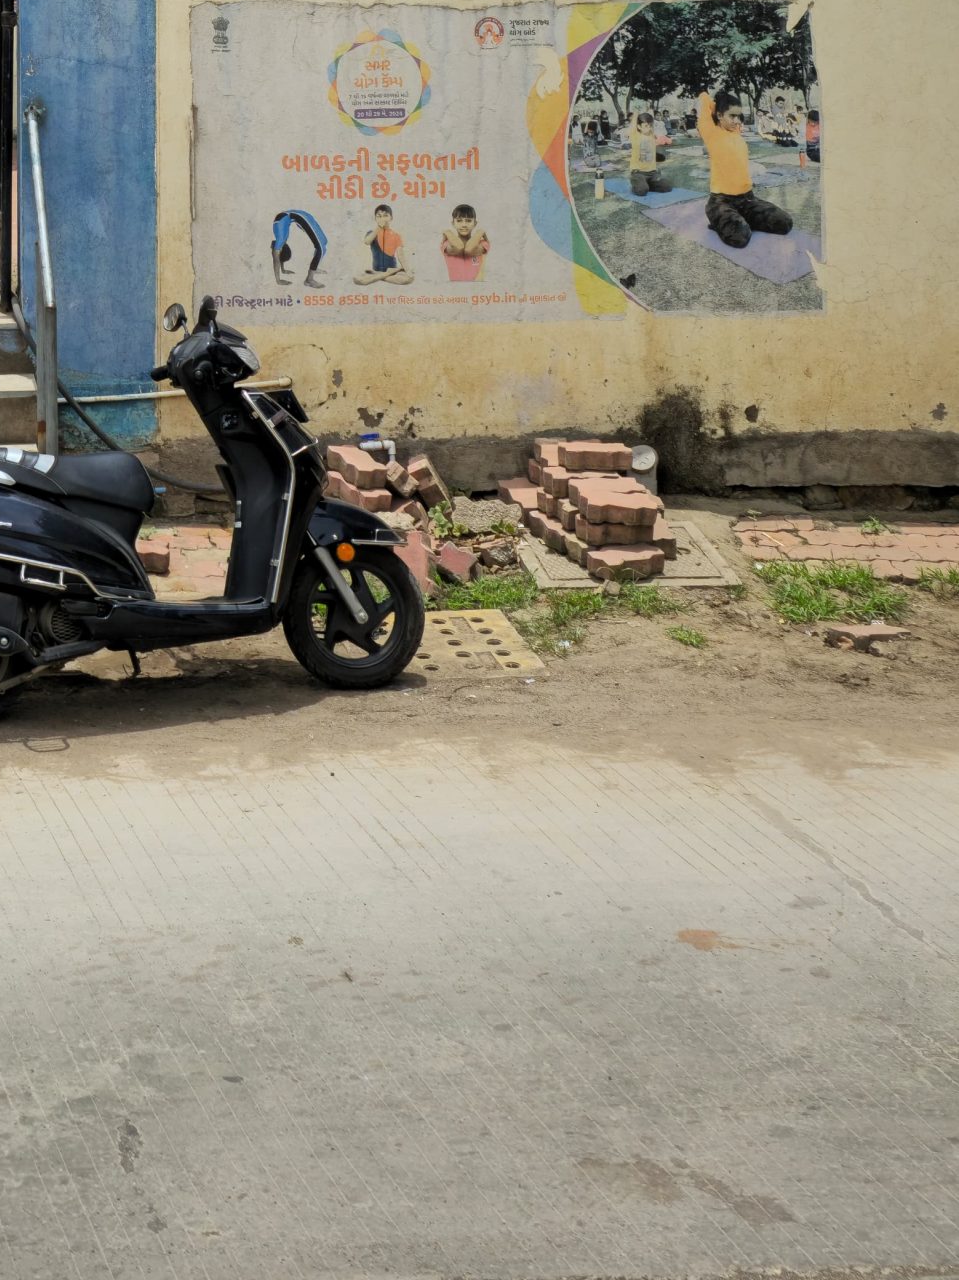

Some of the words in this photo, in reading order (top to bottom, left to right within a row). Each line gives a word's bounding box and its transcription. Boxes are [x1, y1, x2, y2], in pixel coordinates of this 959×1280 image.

[281, 147, 370, 173] બાળકની
[376, 146, 480, 176] સફળતાની
[316, 174, 364, 201] સીડી
[371, 173, 398, 202] છે,
[403, 173, 446, 199] યોગ
[276, 295, 294, 307] માટે
[304, 296, 334, 306] 8558
[339, 294, 369, 306] 8558
[373, 294, 384, 305] 11
[471, 292, 516, 305] gsyb.in
